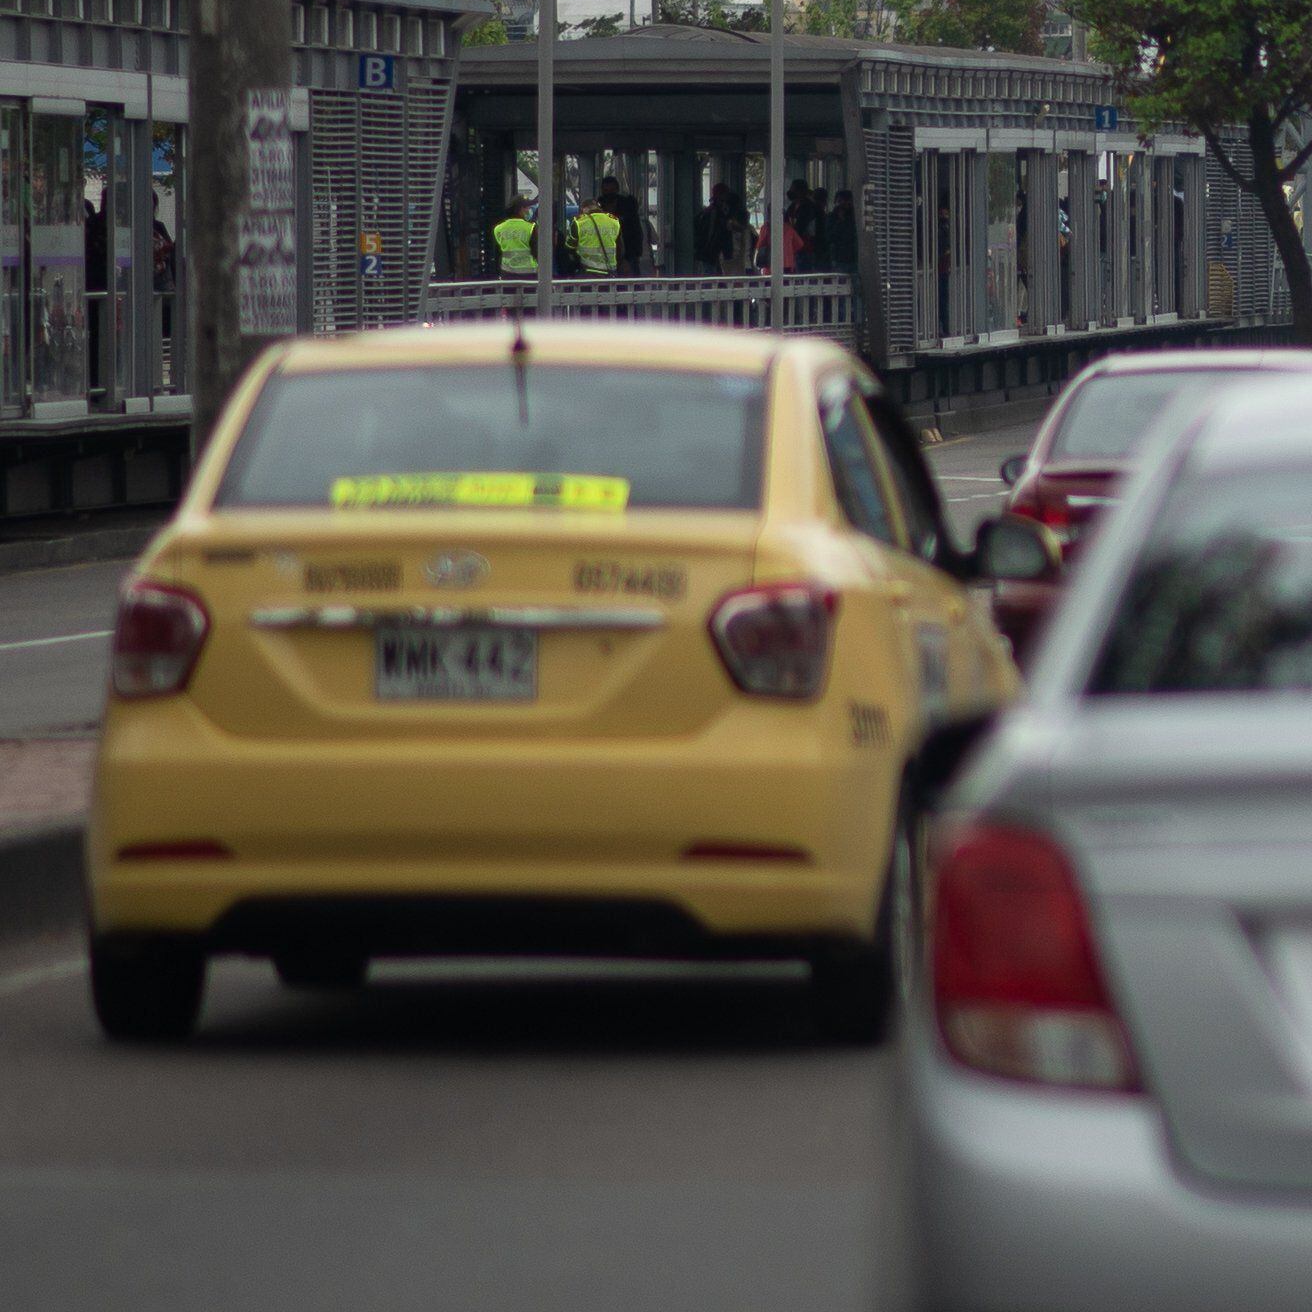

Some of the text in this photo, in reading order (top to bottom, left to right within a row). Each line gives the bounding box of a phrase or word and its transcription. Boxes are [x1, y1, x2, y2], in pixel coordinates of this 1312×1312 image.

[365, 58, 386, 87] B
[1102, 110, 1111, 128] 1
[366, 235, 377, 254] 5
[364, 255, 378, 275] 2
